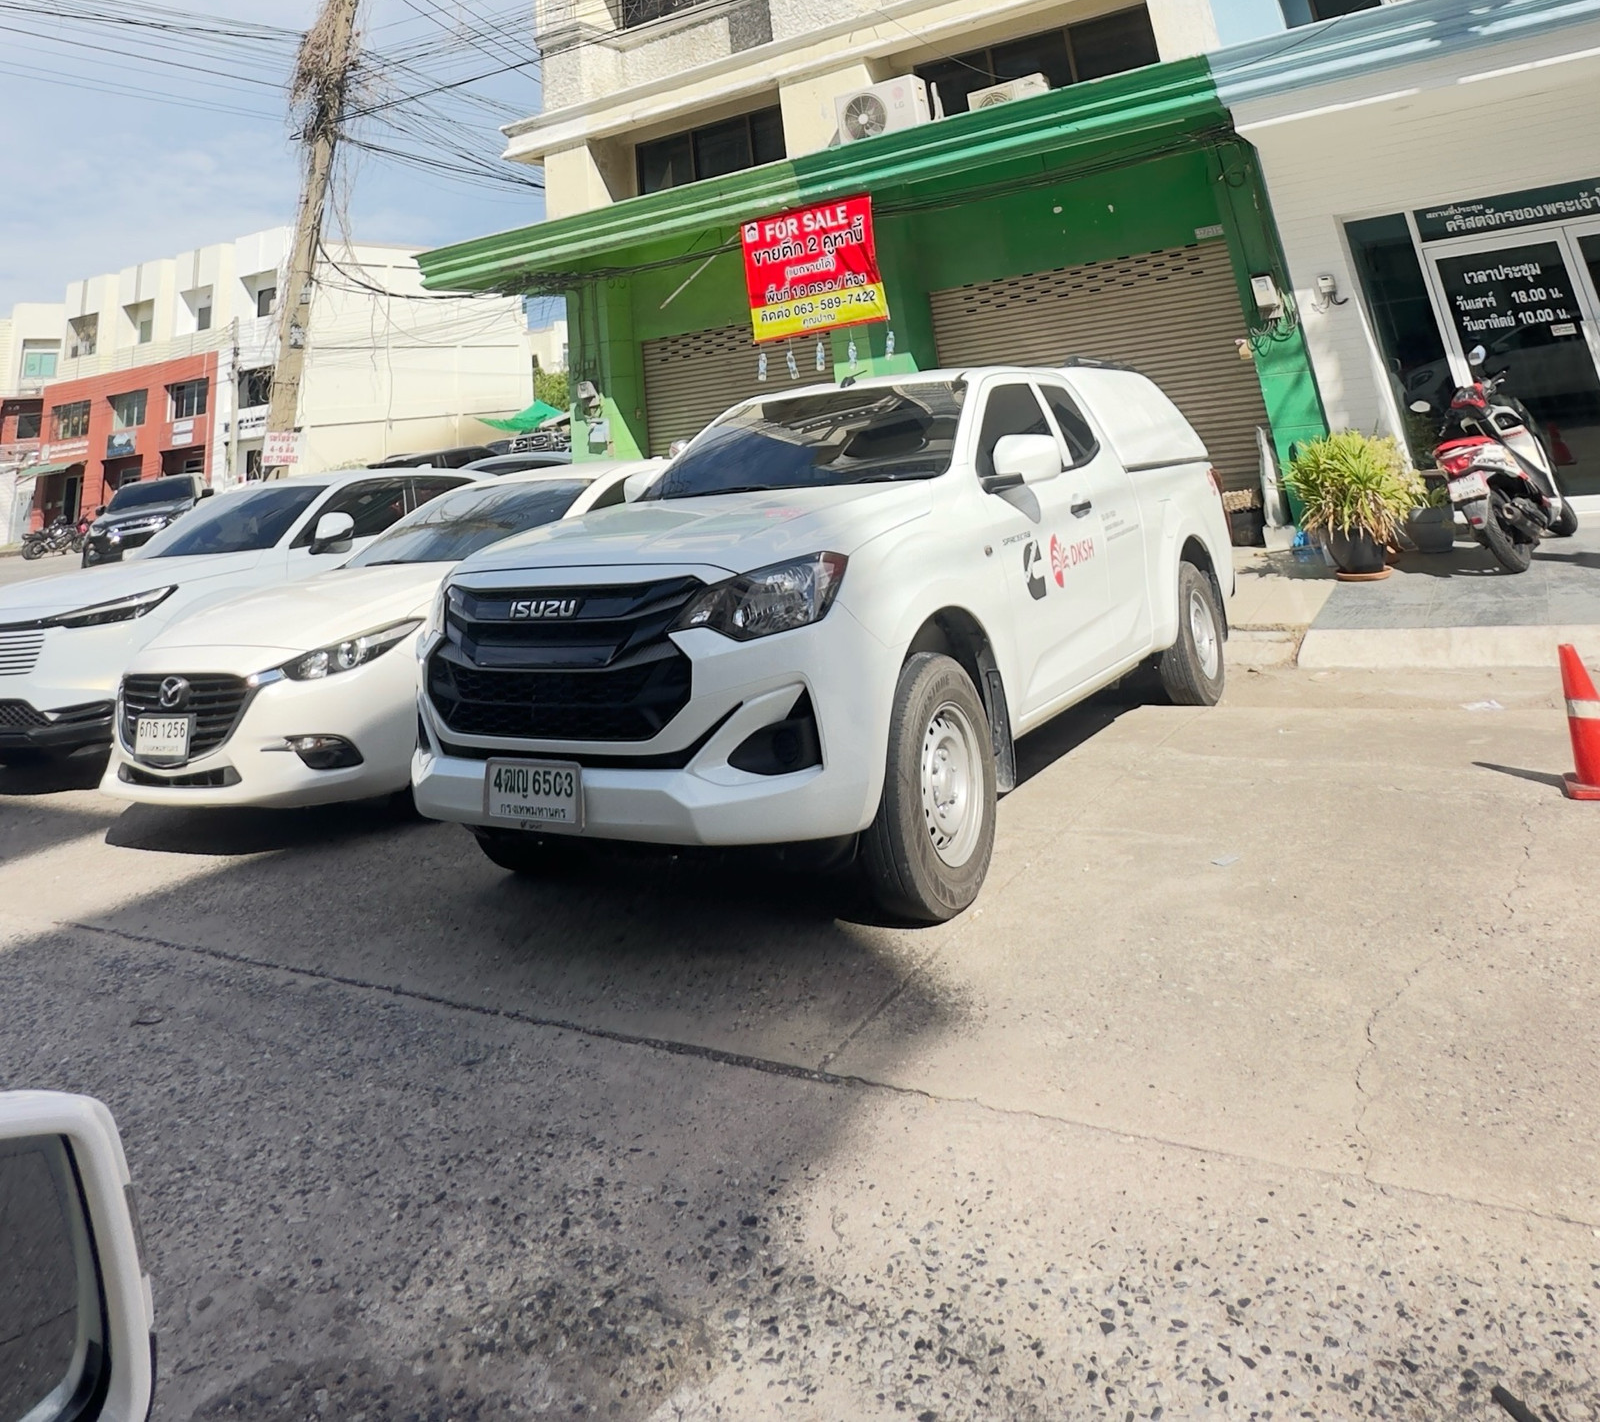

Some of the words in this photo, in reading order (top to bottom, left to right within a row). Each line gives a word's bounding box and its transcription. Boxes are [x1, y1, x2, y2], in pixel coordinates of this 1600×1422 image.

[765, 218, 799, 242] FOR
[803, 206, 849, 232] SALE
[754, 240, 803, 265] ขายตึก
[808, 237, 818, 253] 2
[1463, 262, 1541, 285] เวลาประชุม
[793, 286, 806, 298] 18
[794, 290, 876, 316] 063-589-7422
[1456, 291, 1497, 311] วันเสาร์
[1510, 287, 1547, 304] 18.00
[1549, 287, 1563, 299] น.
[1463, 310, 1516, 332] วันอาทิตย์
[1518, 308, 1554, 325] 10.00
[1556, 308, 1571, 320] น.
[1070, 538, 1095, 566] DKSH
[509, 599, 576, 618] ISUZU
[162, 721, 186, 738] 1256
[532, 769, 574, 798] 6503
